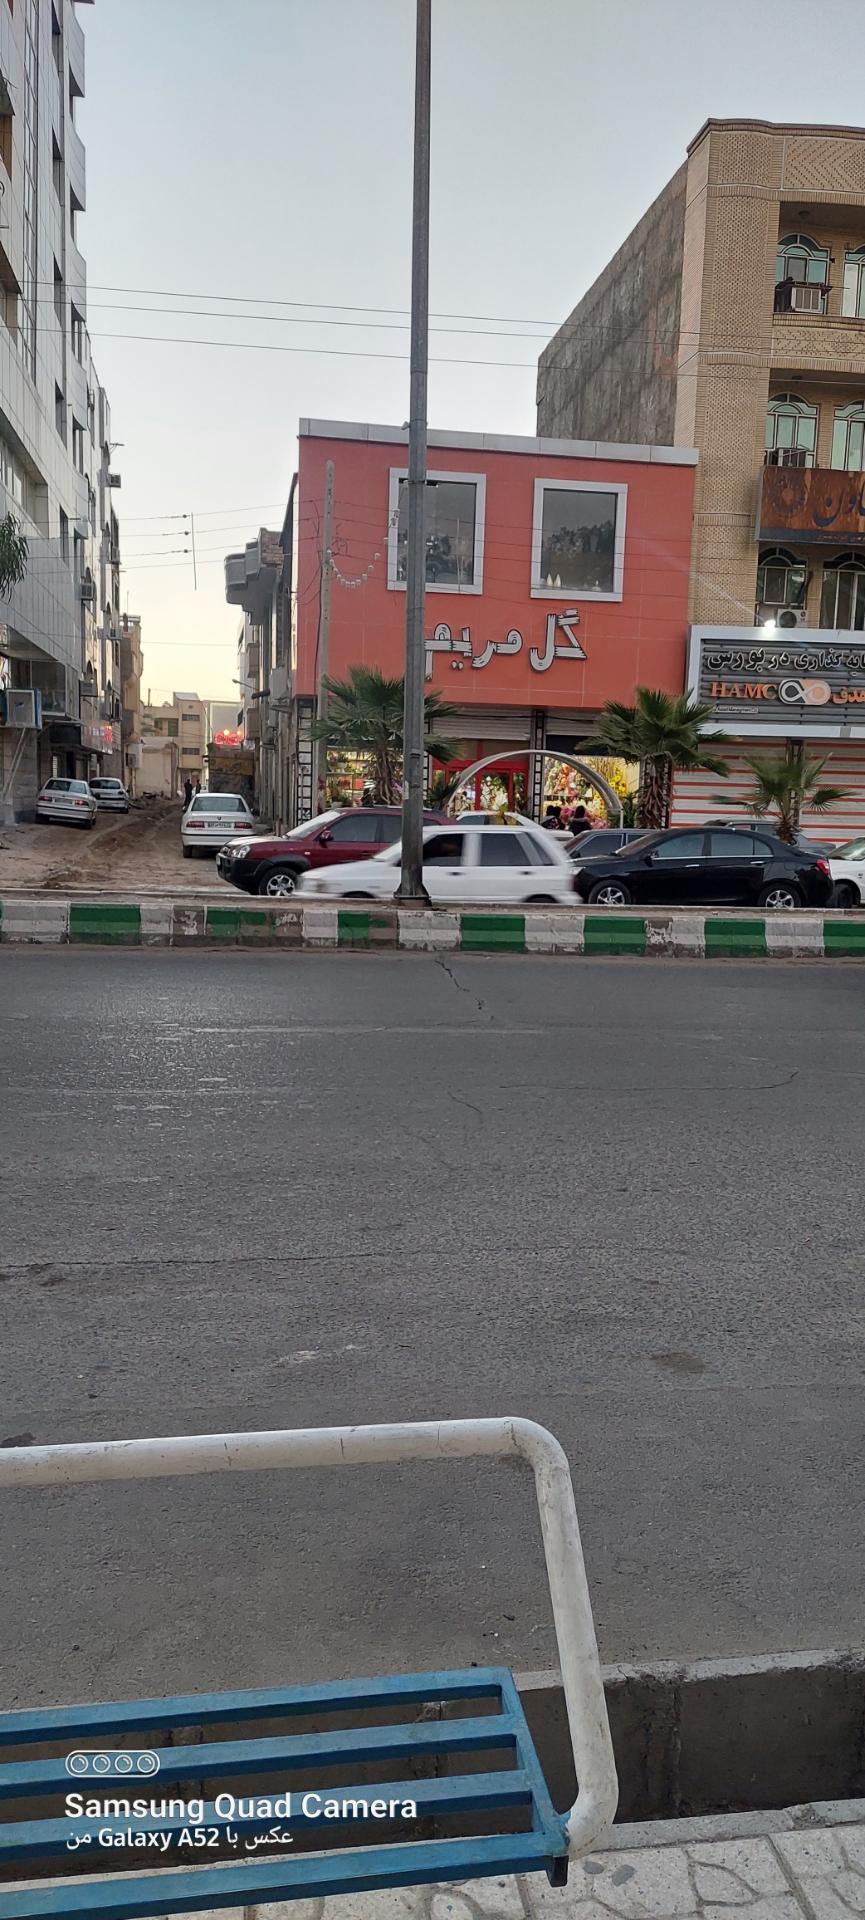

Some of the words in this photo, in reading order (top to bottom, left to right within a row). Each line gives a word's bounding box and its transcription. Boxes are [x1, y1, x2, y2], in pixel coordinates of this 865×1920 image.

[530, 608, 587, 672] گل
[424, 623, 524, 682] مریم
[707, 648, 766, 673] بورس
[768, 651, 791, 670] در
[793, 648, 844, 671] گذاری
[710, 681, 778, 700] HAMC
